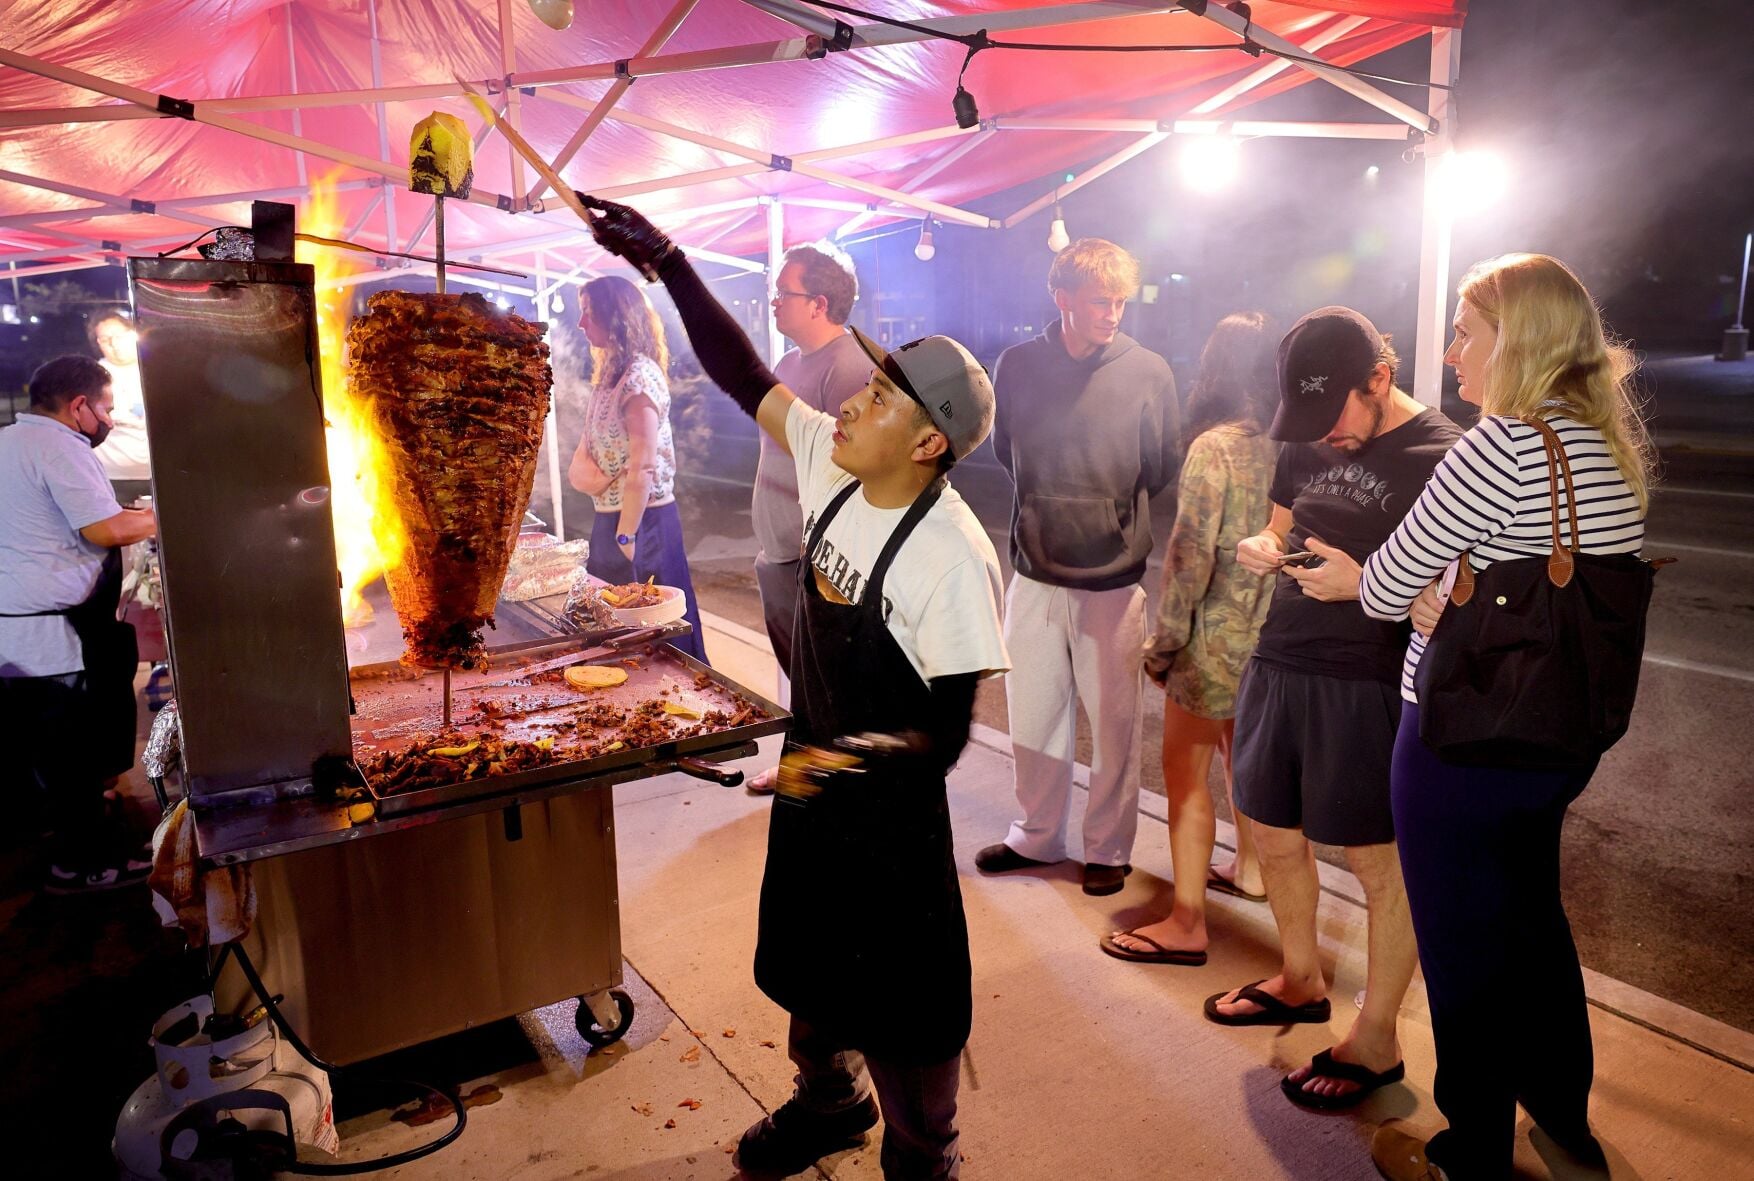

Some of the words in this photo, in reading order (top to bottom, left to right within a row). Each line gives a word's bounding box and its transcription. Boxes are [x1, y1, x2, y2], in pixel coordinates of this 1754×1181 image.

[1326, 483, 1346, 496] ONLY
[1344, 487, 1352, 498] A
[1351, 489, 1374, 507] PHASE
